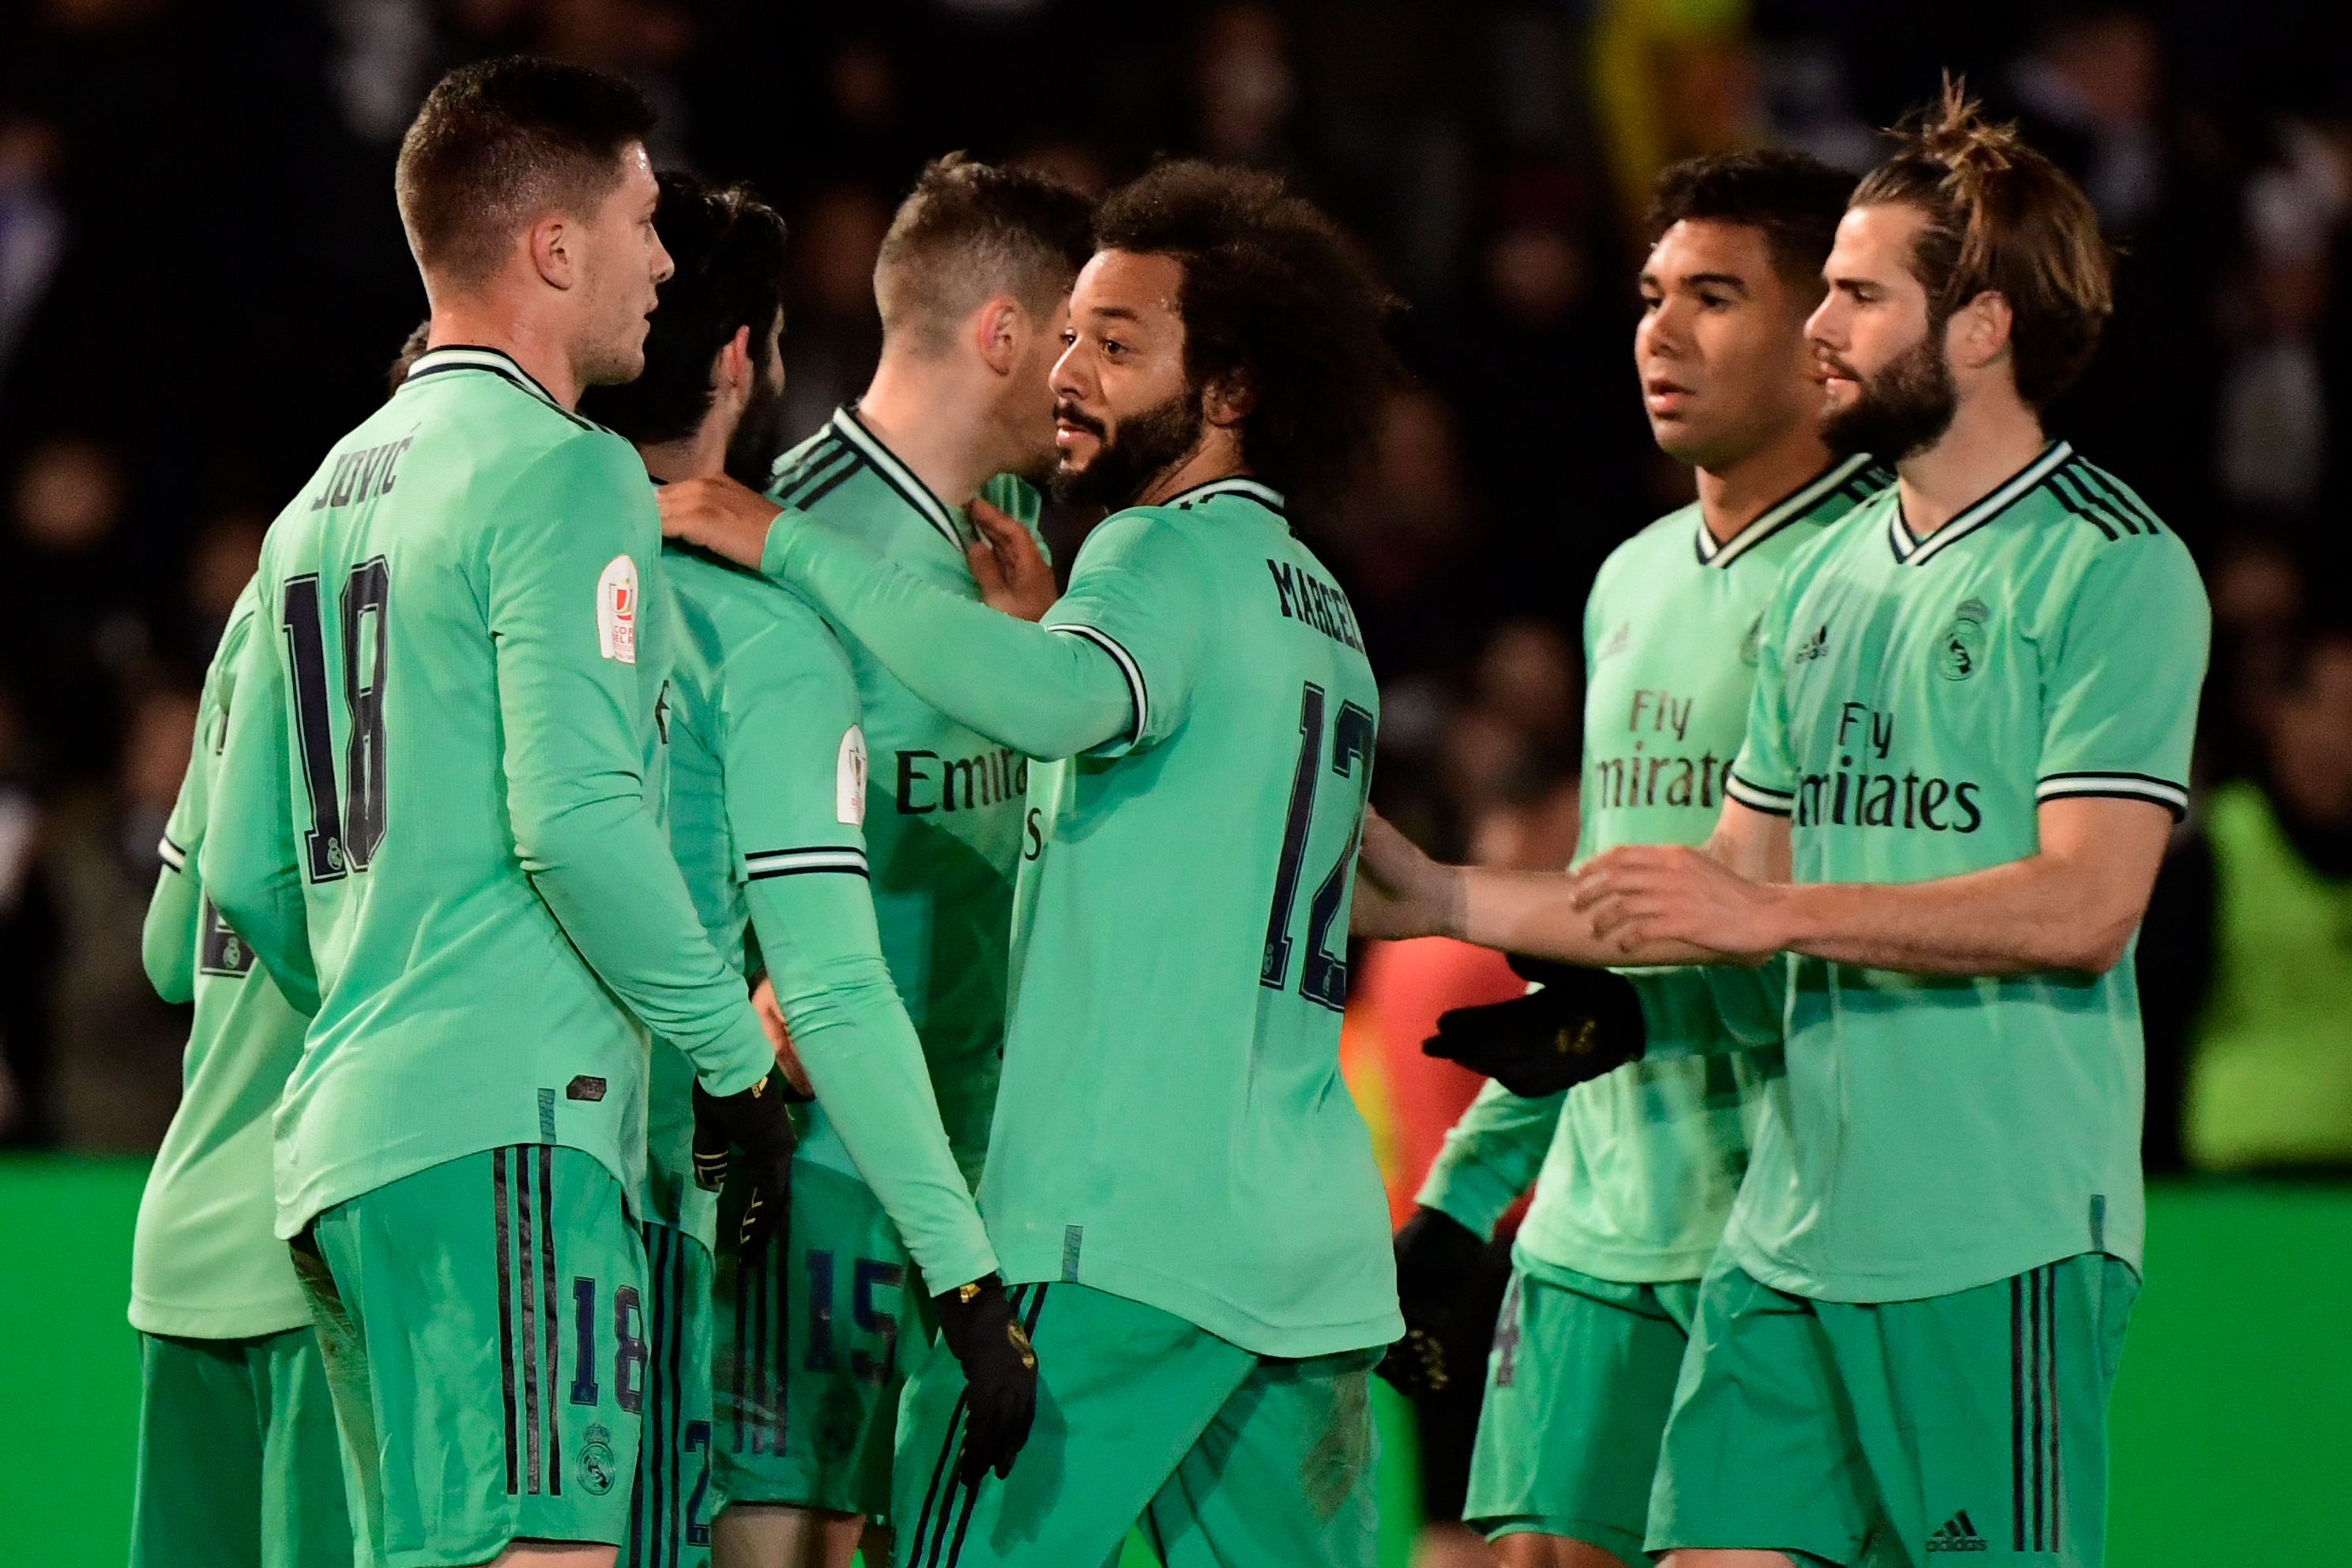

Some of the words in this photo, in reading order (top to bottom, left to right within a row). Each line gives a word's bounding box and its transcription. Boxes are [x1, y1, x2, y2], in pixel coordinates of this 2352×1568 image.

[310, 421, 422, 512] JOVIĆ
[282, 554, 390, 885] 18
[1628, 689, 1693, 742] Fly
[1260, 680, 1375, 1013] 12
[570, 1276, 649, 1415] 18
[803, 1249, 909, 1387] 15
